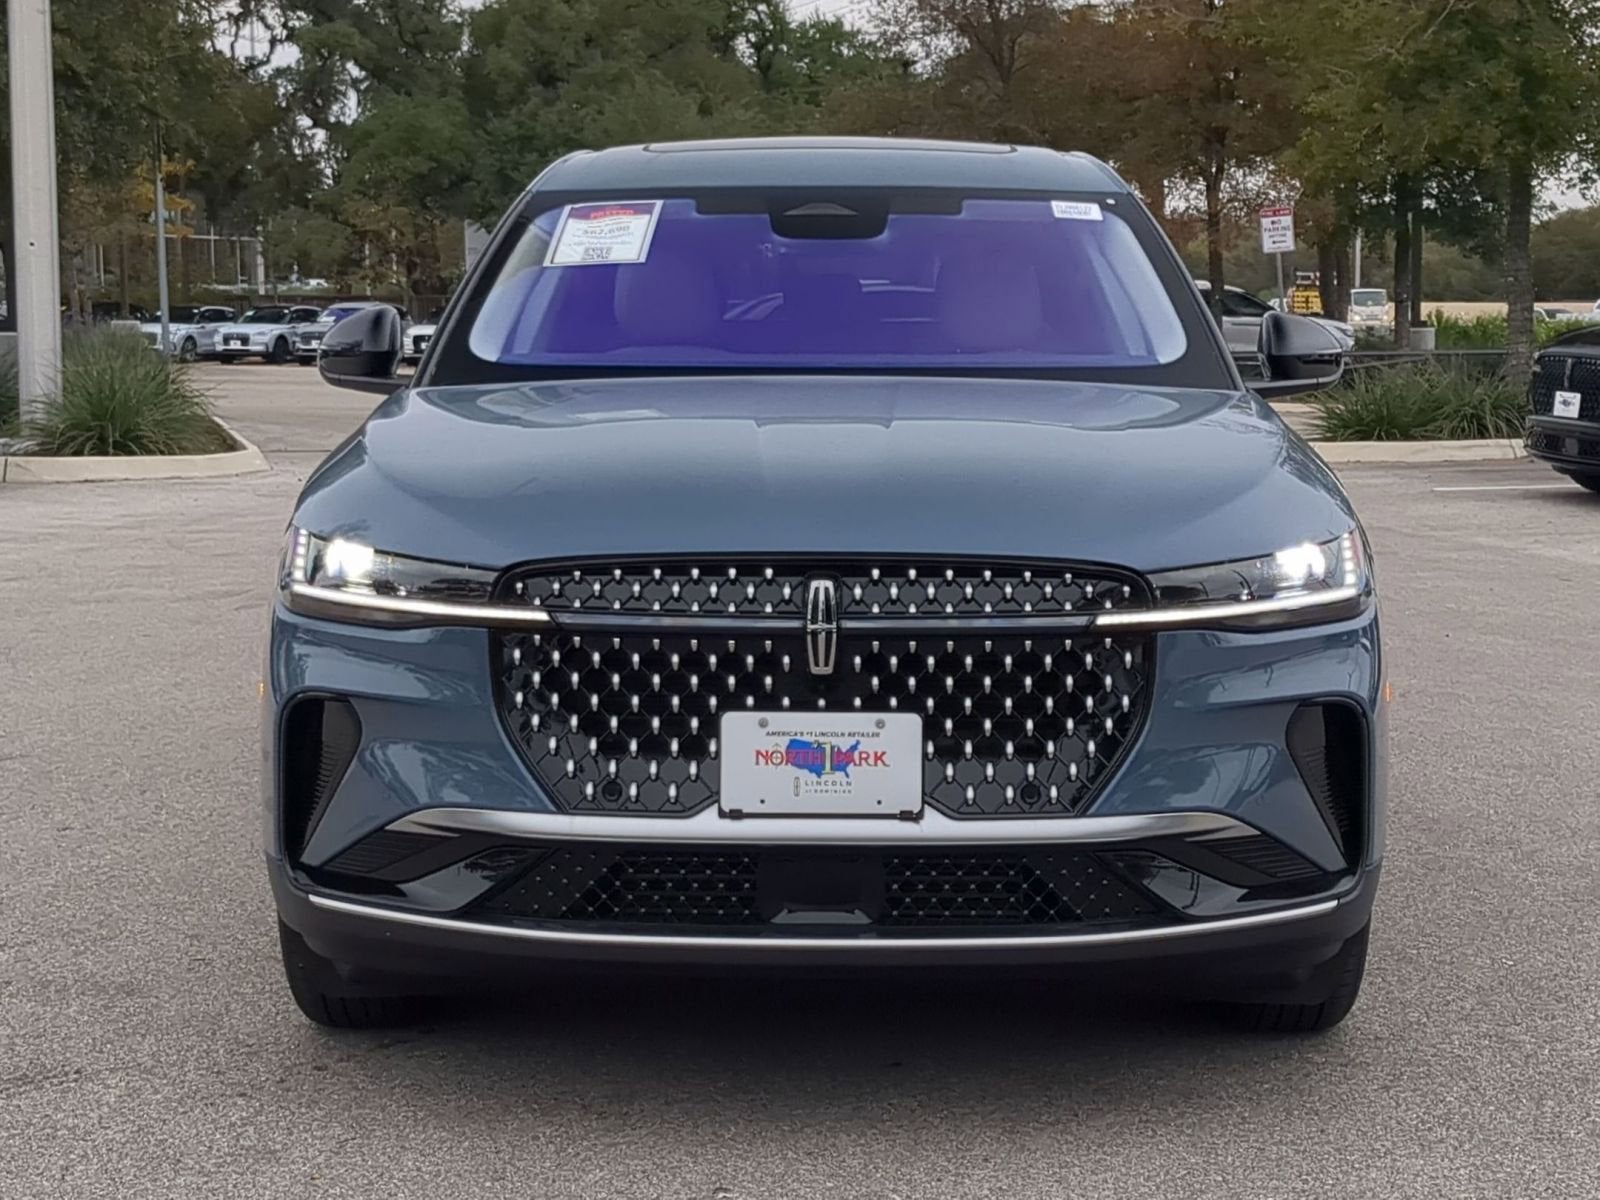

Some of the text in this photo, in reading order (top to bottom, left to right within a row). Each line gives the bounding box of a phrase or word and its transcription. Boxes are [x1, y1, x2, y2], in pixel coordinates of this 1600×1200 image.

[1264, 225, 1291, 233] PARKING
[755, 750, 822, 766] NORTH
[834, 750, 890, 767] PARK
